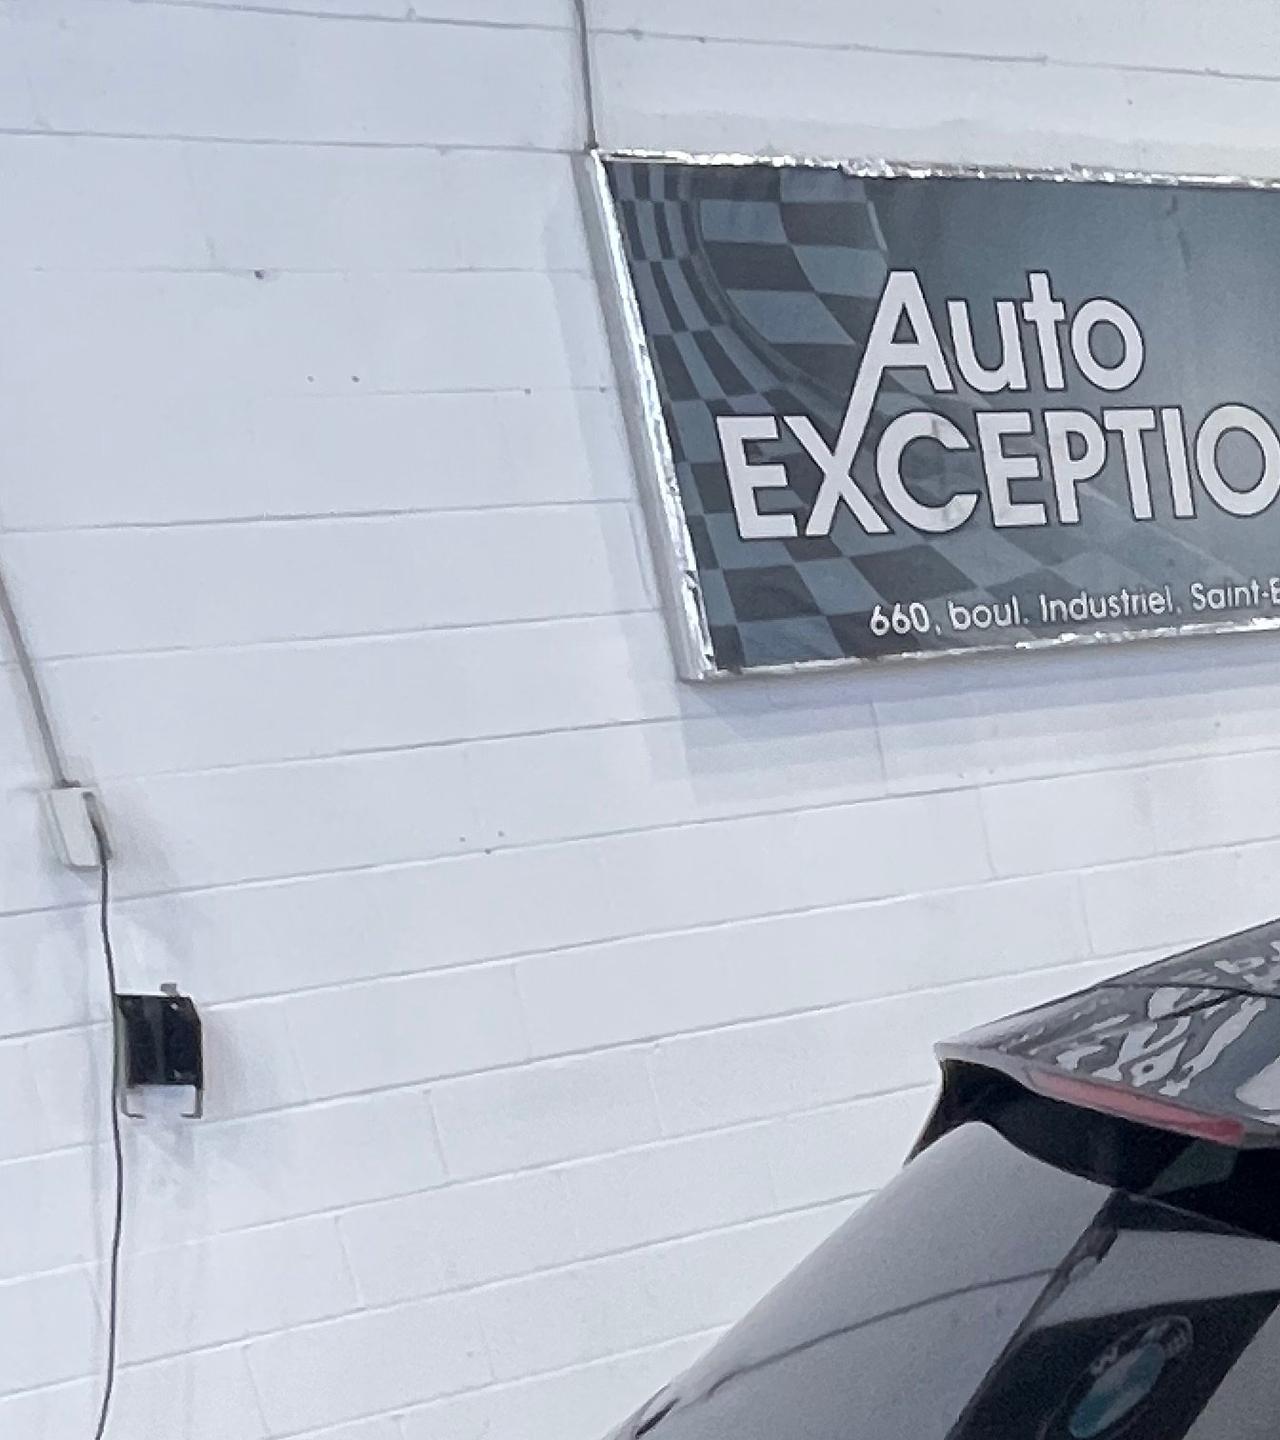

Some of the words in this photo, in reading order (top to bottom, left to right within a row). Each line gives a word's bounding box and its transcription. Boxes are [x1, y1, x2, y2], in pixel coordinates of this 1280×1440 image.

[846, 270, 1145, 396] Auto
[870, 602, 942, 636] 660,
[948, 594, 1029, 631] boul.
